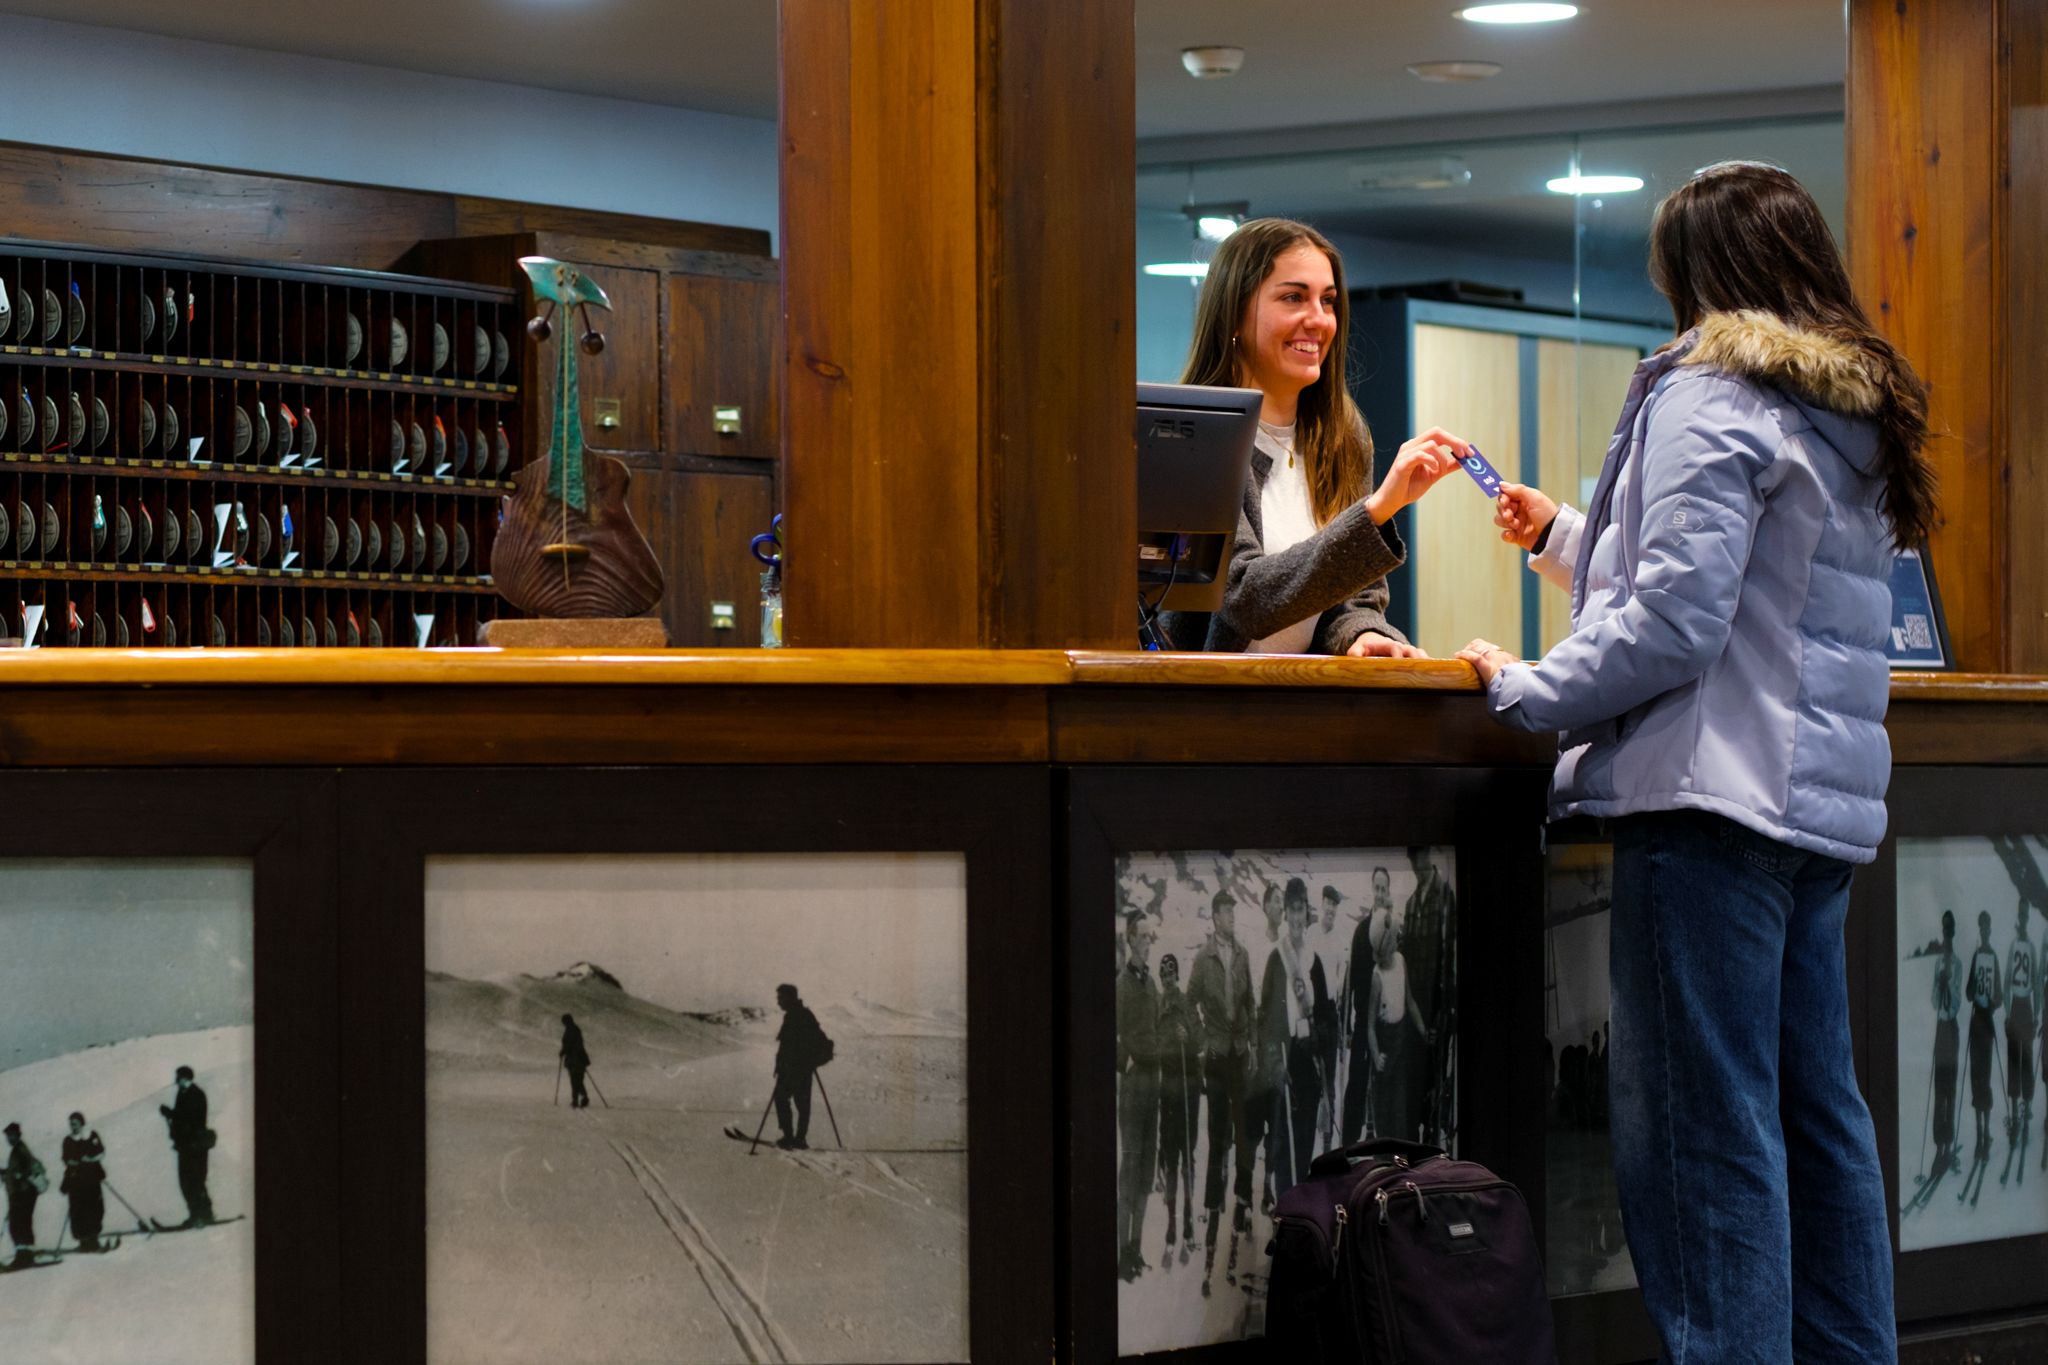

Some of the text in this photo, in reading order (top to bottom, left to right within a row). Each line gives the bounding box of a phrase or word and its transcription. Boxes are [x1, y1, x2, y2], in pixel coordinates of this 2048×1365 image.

[1149, 419, 1195, 439] ASUS
[1674, 512, 1685, 523] S
[1977, 966, 1993, 998] 35
[2013, 951, 2030, 987] 29
